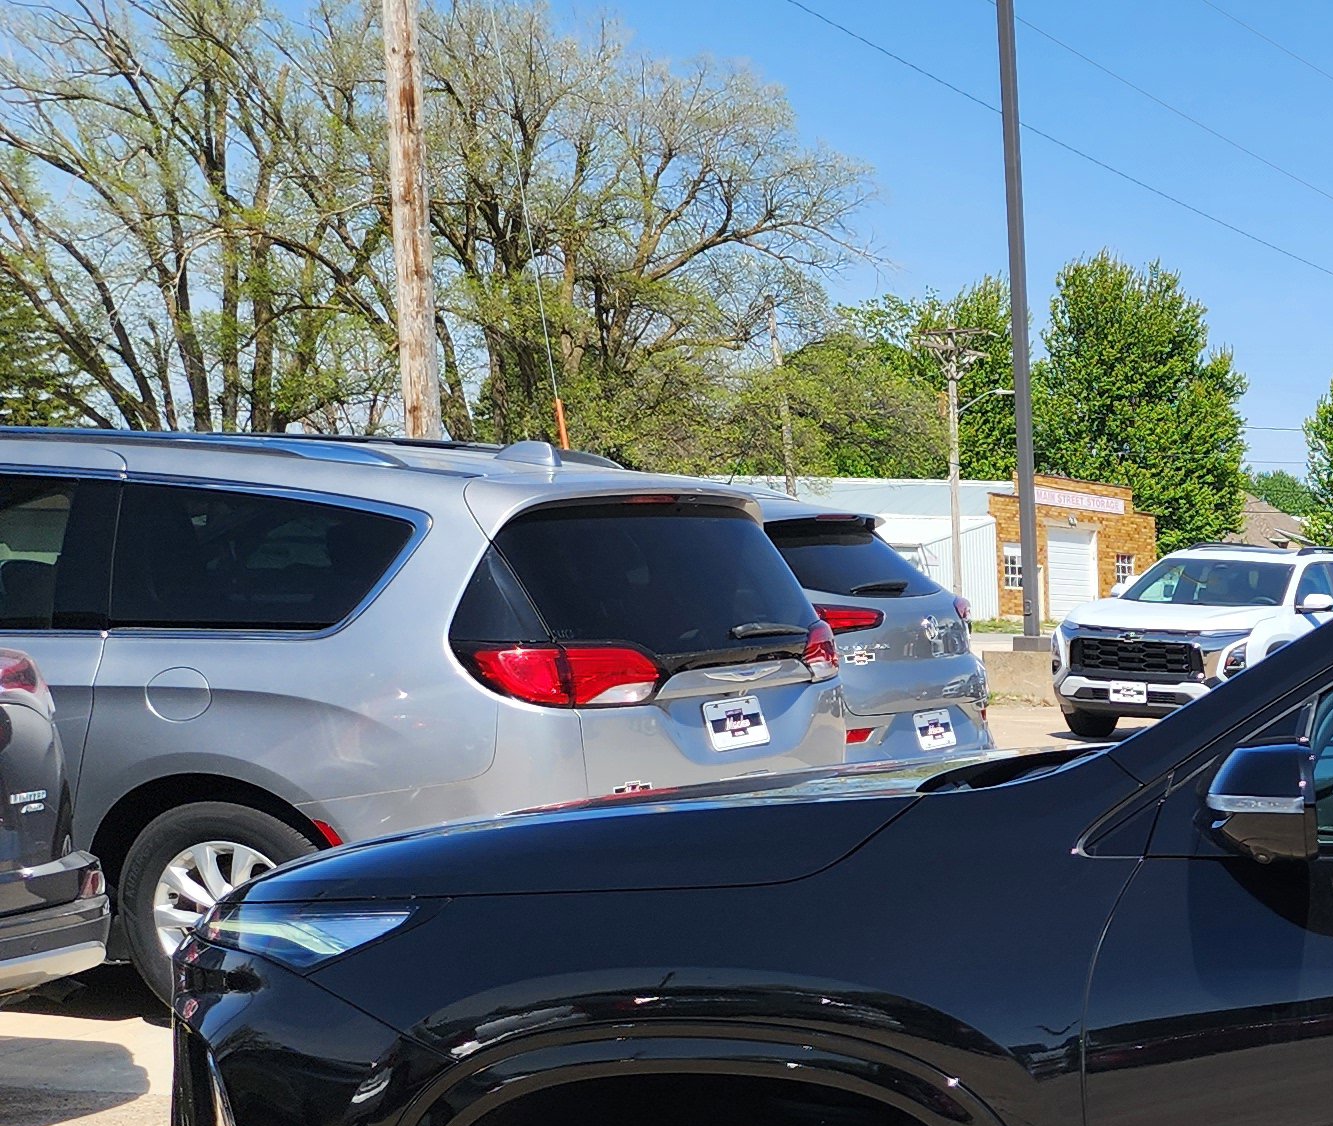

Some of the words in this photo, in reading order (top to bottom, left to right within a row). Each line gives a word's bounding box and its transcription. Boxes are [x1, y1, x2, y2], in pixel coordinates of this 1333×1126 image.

[1035, 489, 1056, 501] MAIN
[1057, 494, 1084, 505] STREET
[1087, 498, 1120, 511] STORAGE
